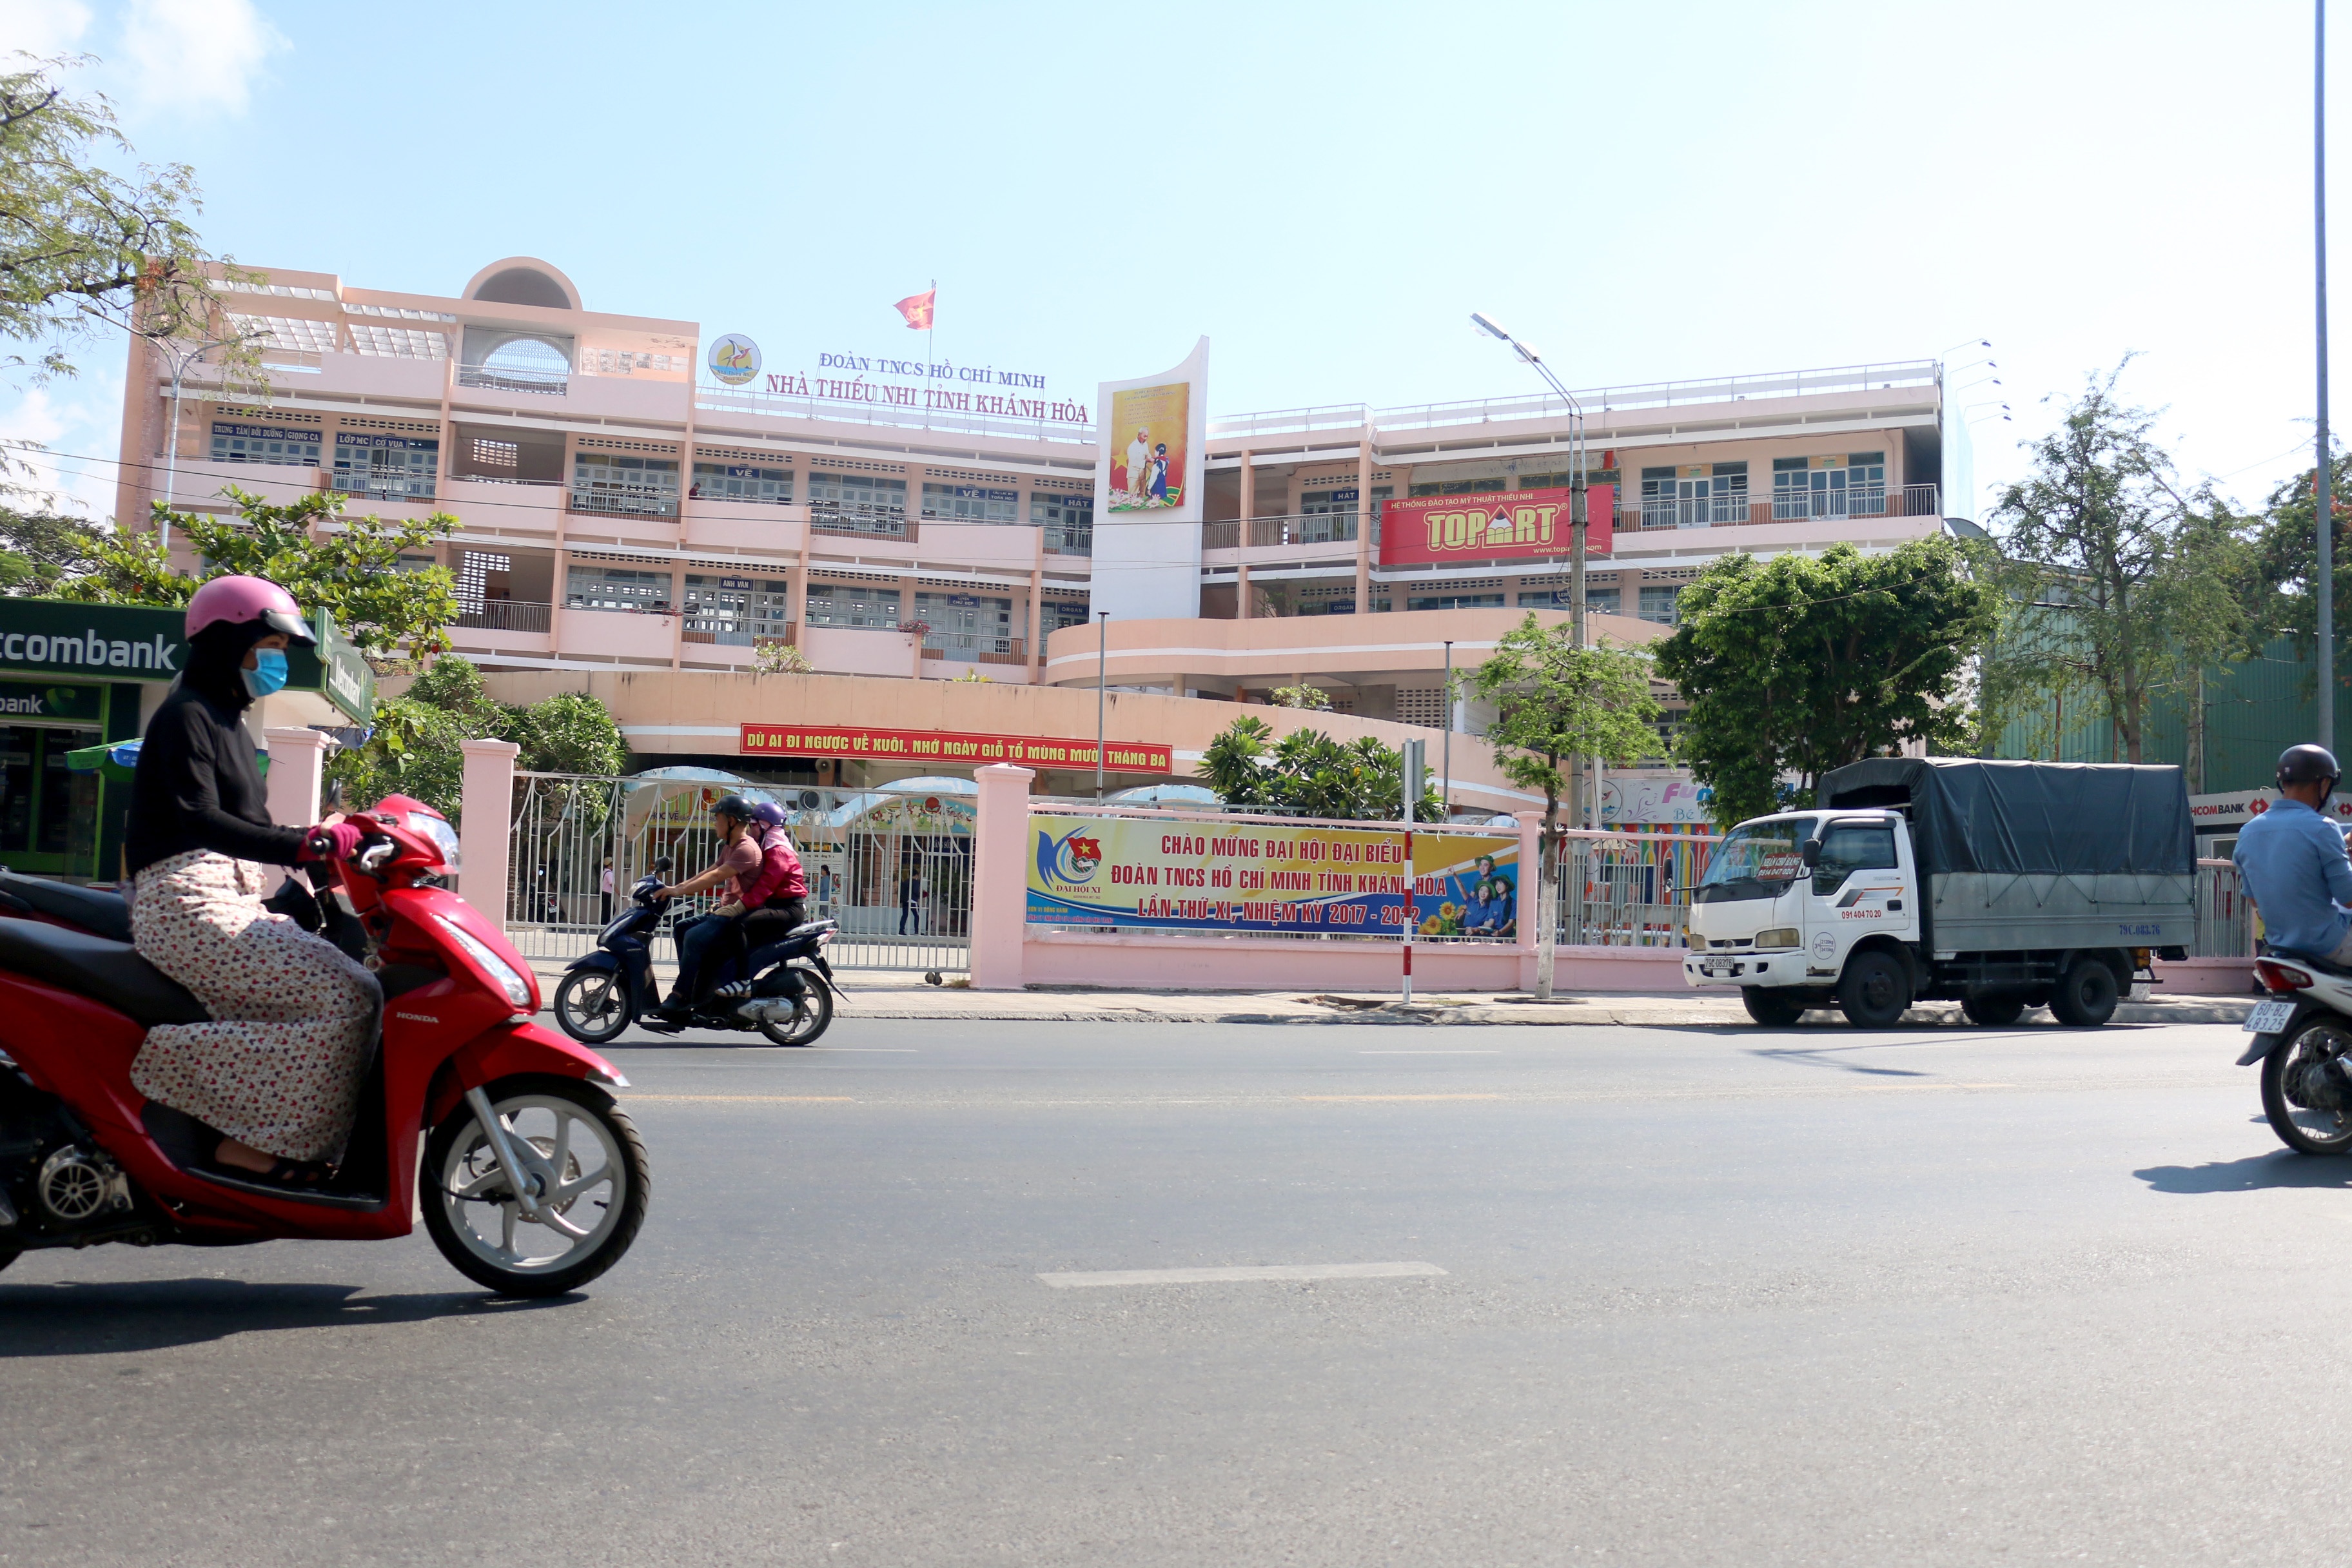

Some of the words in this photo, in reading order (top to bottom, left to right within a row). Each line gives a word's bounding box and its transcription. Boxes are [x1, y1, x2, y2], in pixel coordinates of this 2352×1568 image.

[819, 351, 870, 371] ĐOÀN
[877, 359, 924, 376] TNCS
[930, 358, 953, 378] HỒ
[959, 365, 992, 383] CHÍ
[998, 371, 1046, 389] MINH
[766, 371, 809, 395] NHÀ
[816, 374, 876, 402] THIẾU
[882, 385, 917, 406] NHI
[924, 384, 970, 411] TỈNH
[975, 393, 1046, 418] KHÁNH
[1051, 398, 1088, 423] HÒA
[214, 425, 233, 434] TRUNG
[236, 426, 248, 435] TÂM
[288, 431, 308, 441] GIỌNG
[339, 434, 356, 444] LỚP
[375, 438, 387, 446] CỜ
[1402, 500, 1426, 508] THỐNG
[1428, 498, 1443, 507] ĐÀO
[1445, 498, 1458, 507] TẠO
[1460, 496, 1471, 504] MỸ
[1473, 495, 1496, 504] THUẬT
[1497, 493, 1518, 502] THIẾU
[0, 629, 177, 670] combank
[747, 731, 765, 747] DÙ
[769, 734, 782, 748] AI
[786, 735, 800, 748] ĐI
[805, 734, 848, 752] NGƯỢC
[853, 732, 869, 750] VỀ
[873, 736, 908, 753] XUÔI,
[912, 738, 940, 754] NHỚ
[944, 740, 977, 756] NGÀY
[981, 740, 1004, 758] GIỖ
[1008, 740, 1024, 759] TỔ
[1027, 744, 1066, 761] MÙNG
[1070, 747, 1100, 763] MƯỜ
[1107, 749, 1146, 766] THÁNG
[1150, 753, 1166, 767] BA
[1673, 808, 1695, 821] Bé
[1161, 832, 1206, 855] CHÀO
[1211, 834, 1259, 858] MỪNG
[1265, 839, 1293, 863] ĐẠI
[1299, 838, 1326, 865] HỘI
[1332, 843, 1360, 865] ĐẠI
[1366, 838, 1402, 864] BIỂU
[1110, 863, 1158, 885] ĐOÀN
[1164, 867, 1205, 887] TNCS
[1211, 864, 1232, 888] HỒ
[1239, 867, 1265, 889] CHÍ
[1271, 871, 1311, 891] MINH
[1317, 868, 1352, 892] TỈNH
[1415, 874, 1447, 896] HÒA
[1056, 885, 1072, 894] ĐẠI
[1073, 885, 1089, 894] HỘI
[1138, 893, 1171, 917] LẦN
[1177, 896, 1209, 919] THỨ
[1215, 900, 1236, 923] XI,
[1243, 899, 1297, 926] NHIỆM
[1301, 900, 1323, 923] KỲ
[1329, 904, 1367, 924] 2017
[2119, 924, 2161, 936] 79C.083.76
[397, 1012, 439, 1024] HONDA
